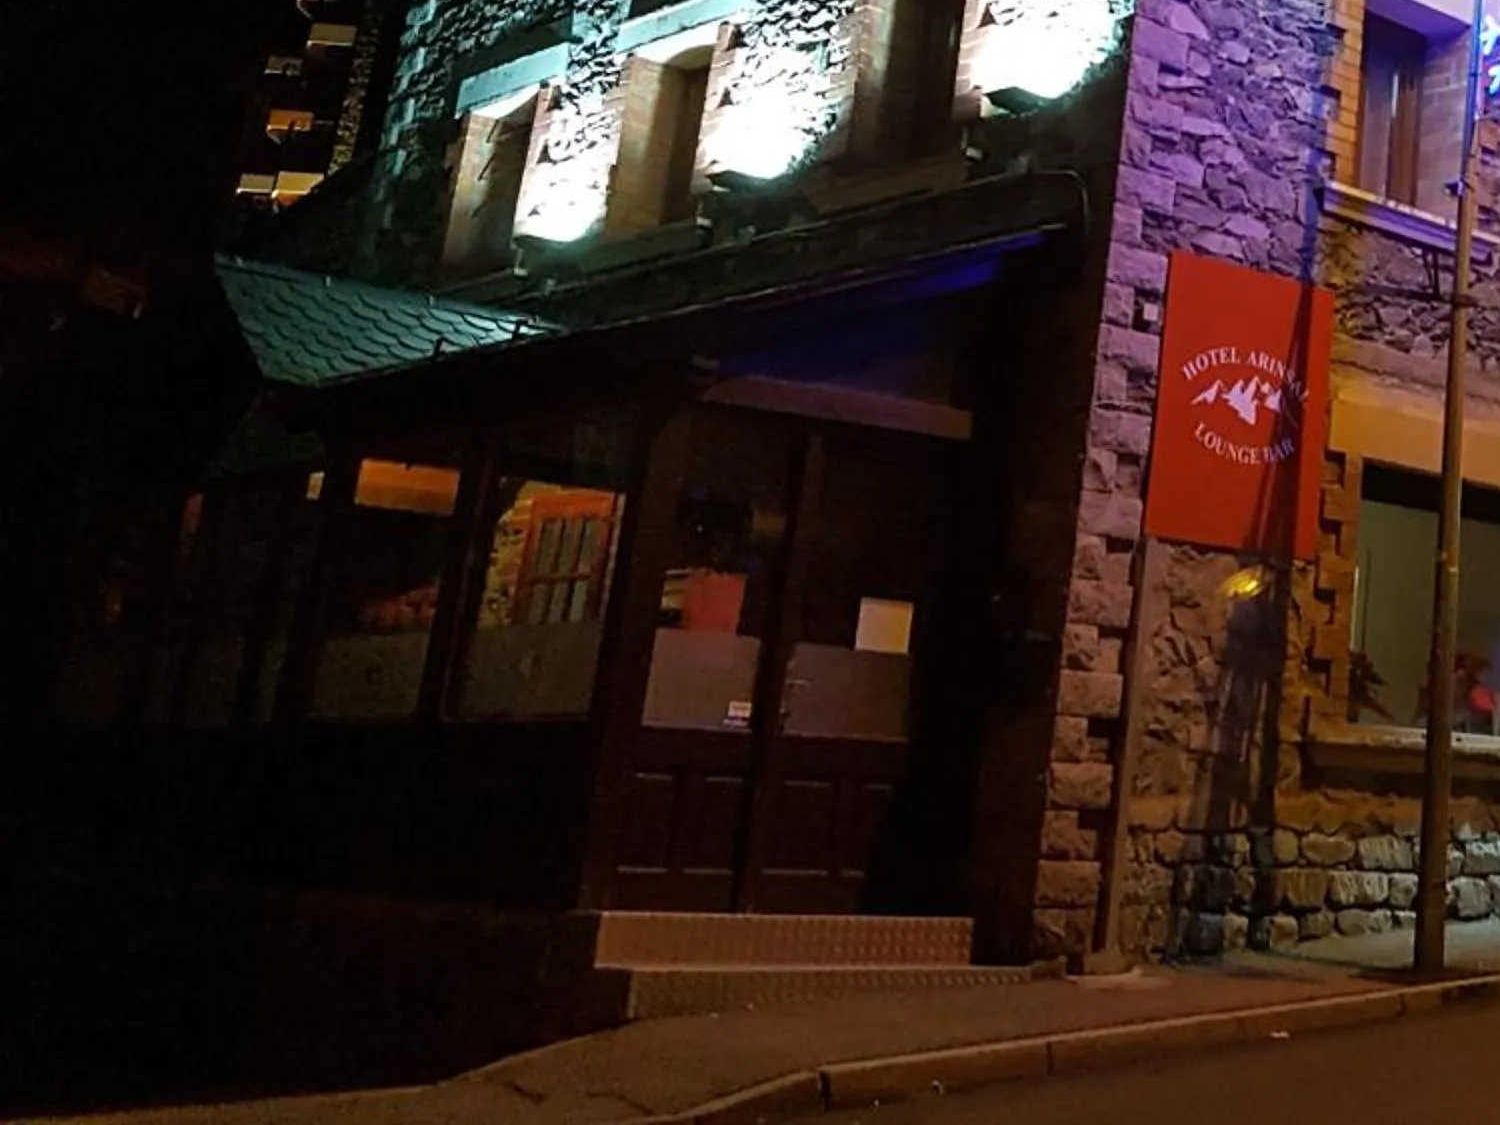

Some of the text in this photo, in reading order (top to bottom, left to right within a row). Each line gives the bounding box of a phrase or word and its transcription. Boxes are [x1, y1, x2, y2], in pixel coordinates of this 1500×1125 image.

[1182, 346, 1241, 380] HOTEL
[1193, 422, 1295, 465] LOUNGE BAR
